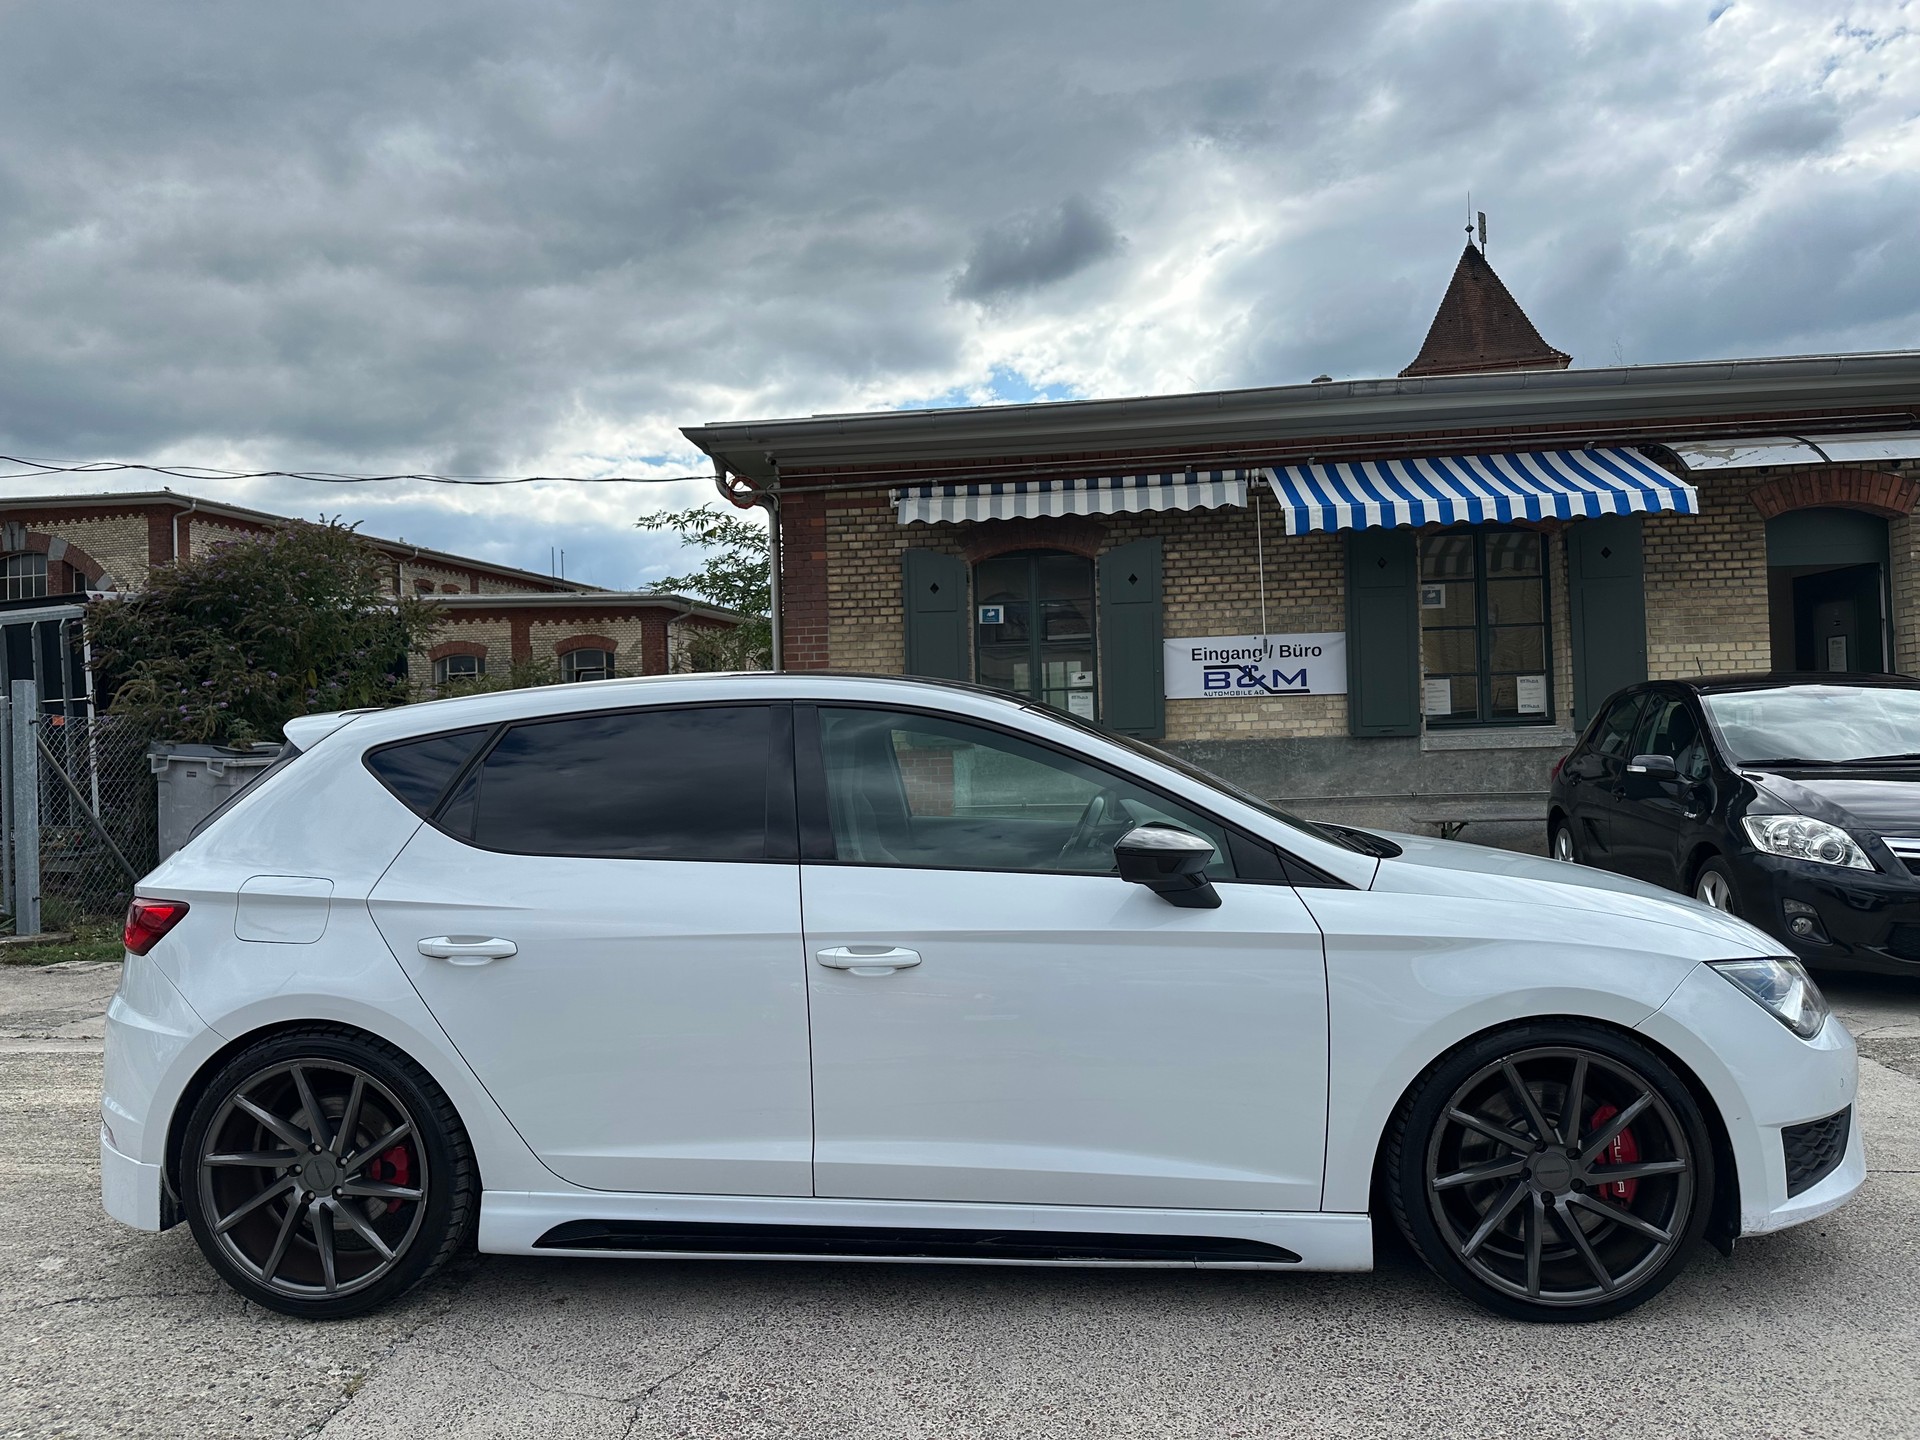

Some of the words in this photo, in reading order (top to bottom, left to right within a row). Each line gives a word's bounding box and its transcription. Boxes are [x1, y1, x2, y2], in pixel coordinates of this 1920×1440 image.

[1191, 648, 1263, 663] Eingang
[1279, 644, 1322, 658] Büro
[1203, 665, 1307, 690] B&M
